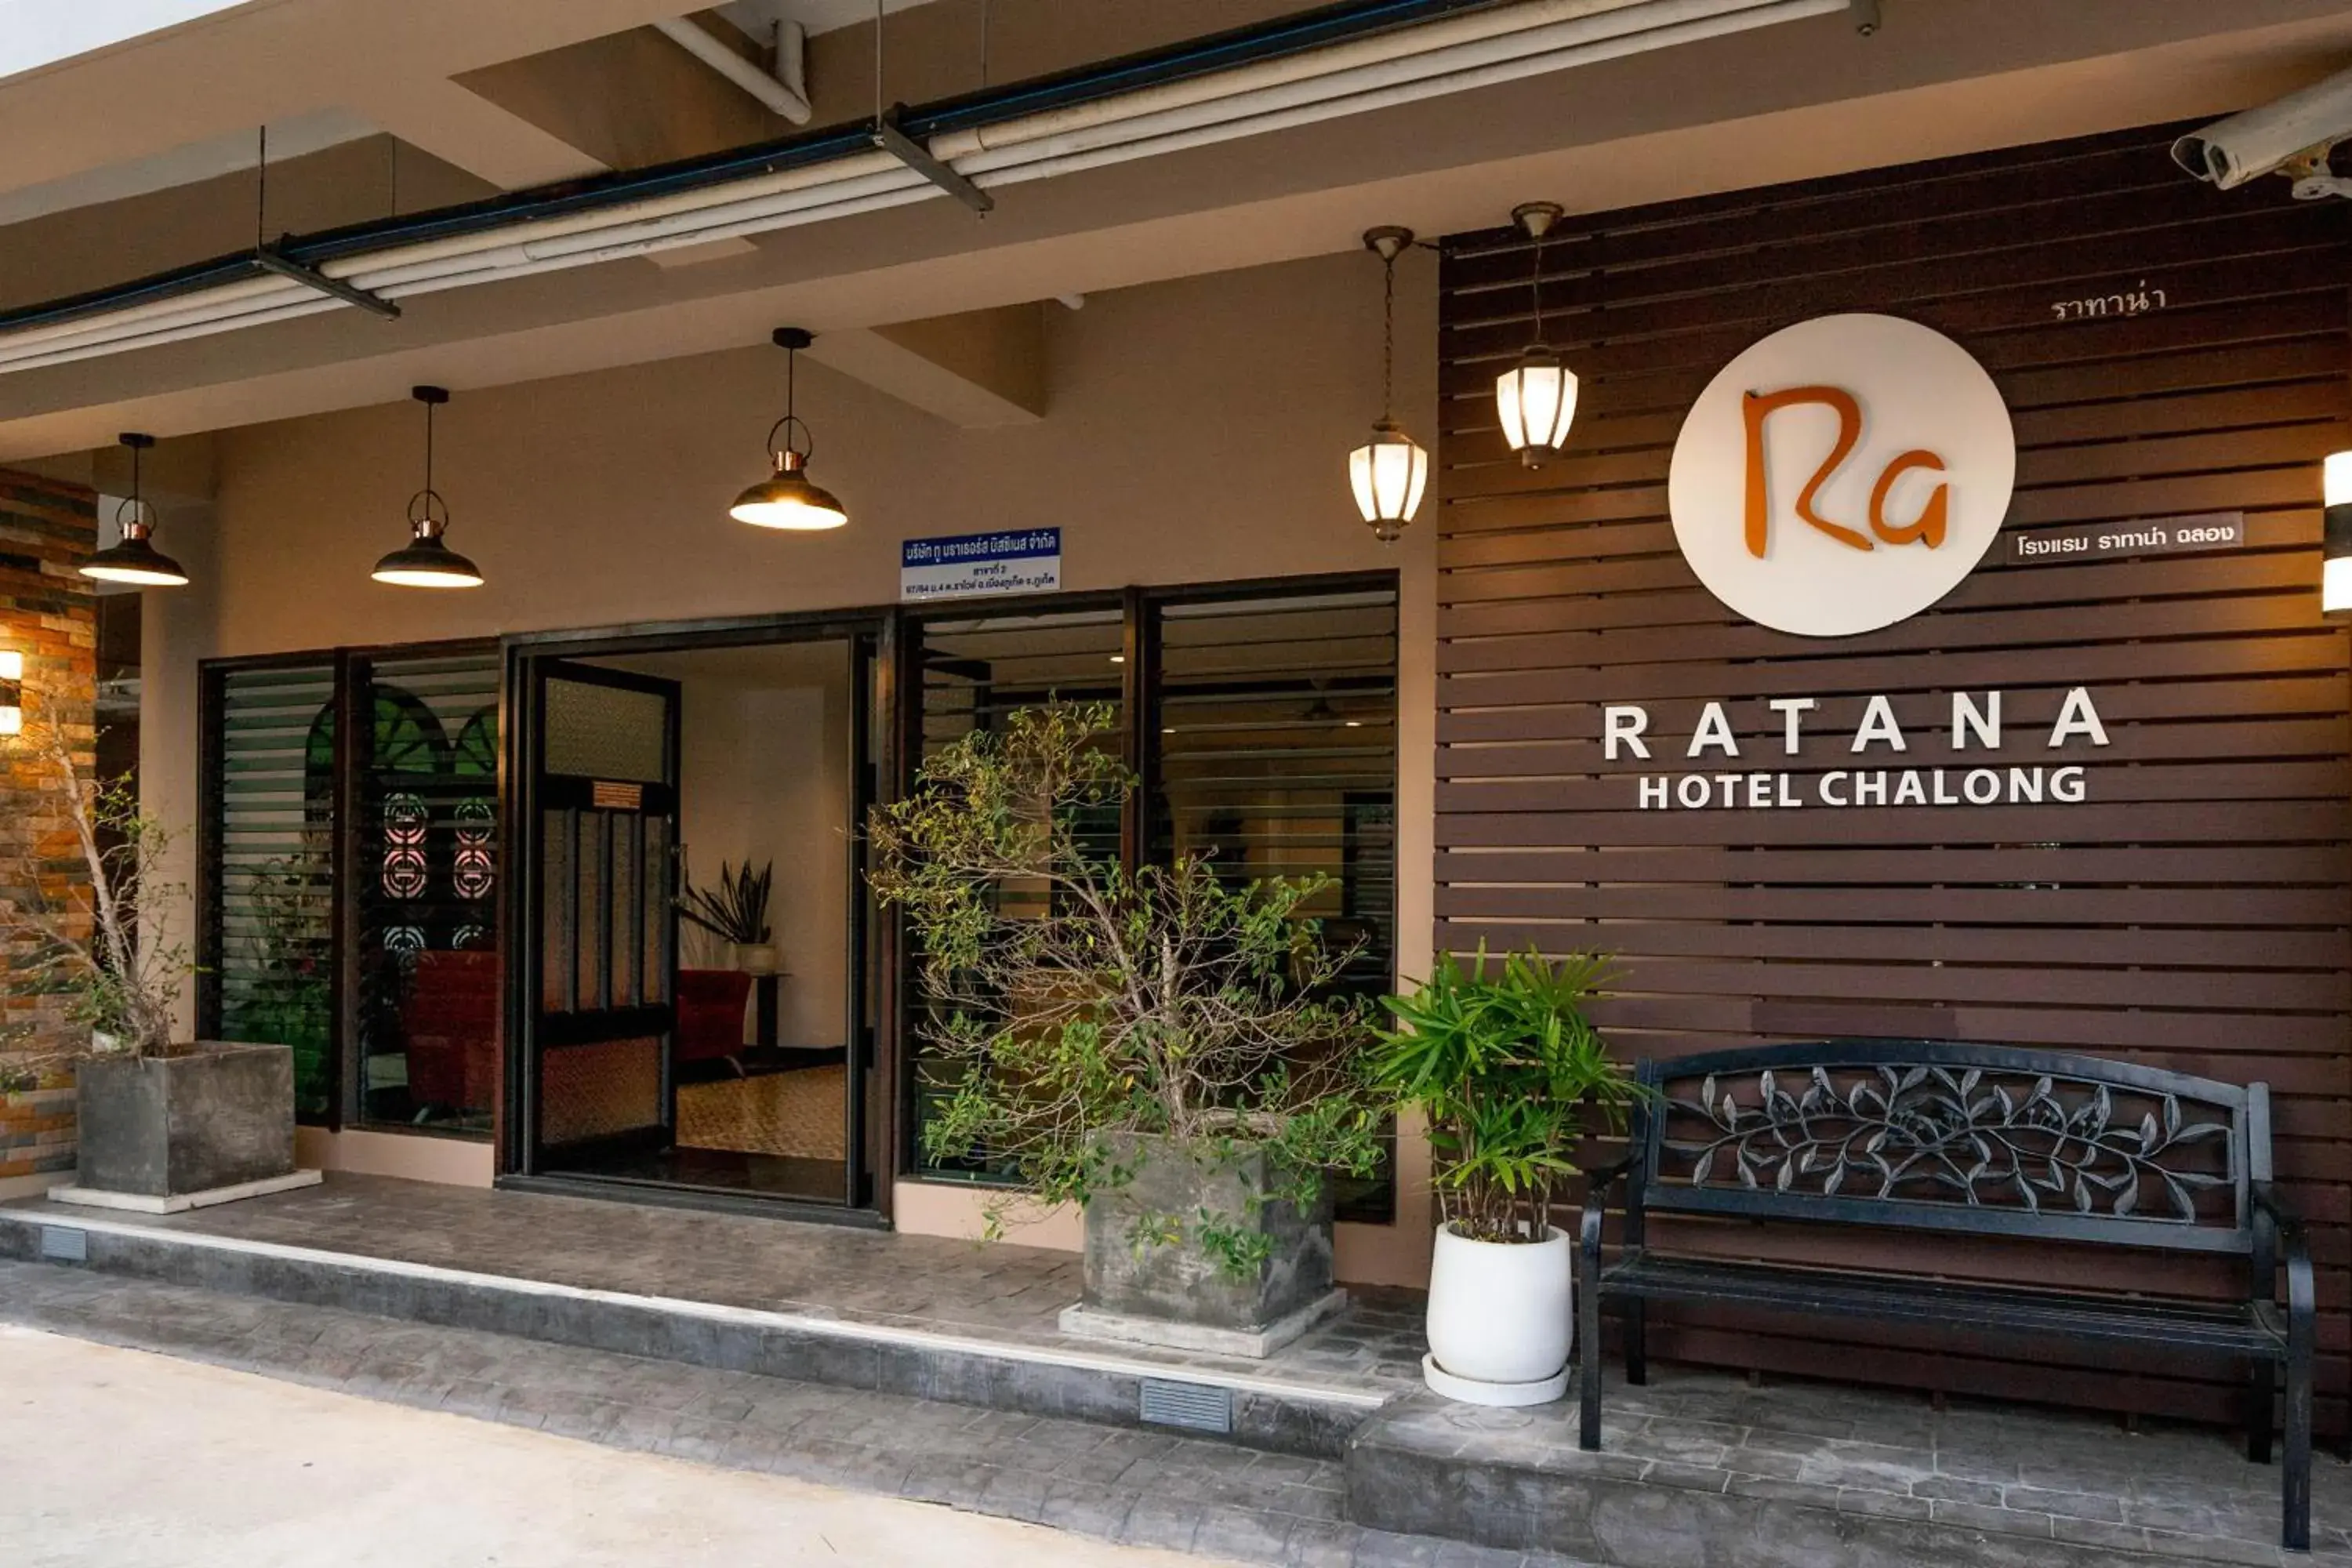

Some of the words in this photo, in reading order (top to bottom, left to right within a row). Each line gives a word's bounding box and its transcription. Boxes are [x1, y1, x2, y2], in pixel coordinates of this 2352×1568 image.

[2051, 280, 2166, 320] ราทาน่า
[1742, 385, 1948, 560] Ra
[906, 543, 932, 560] บริษัท
[1029, 532, 1056, 550] จำกัด
[2017, 535, 2089, 556] โรงแรม
[2098, 526, 2166, 550] ราทาน่า
[2176, 526, 2235, 545] ฉลอง
[1603, 686, 2111, 760] RATANA
[1639, 773, 1802, 809] HOTEL
[1818, 766, 2086, 806] CHALONG
